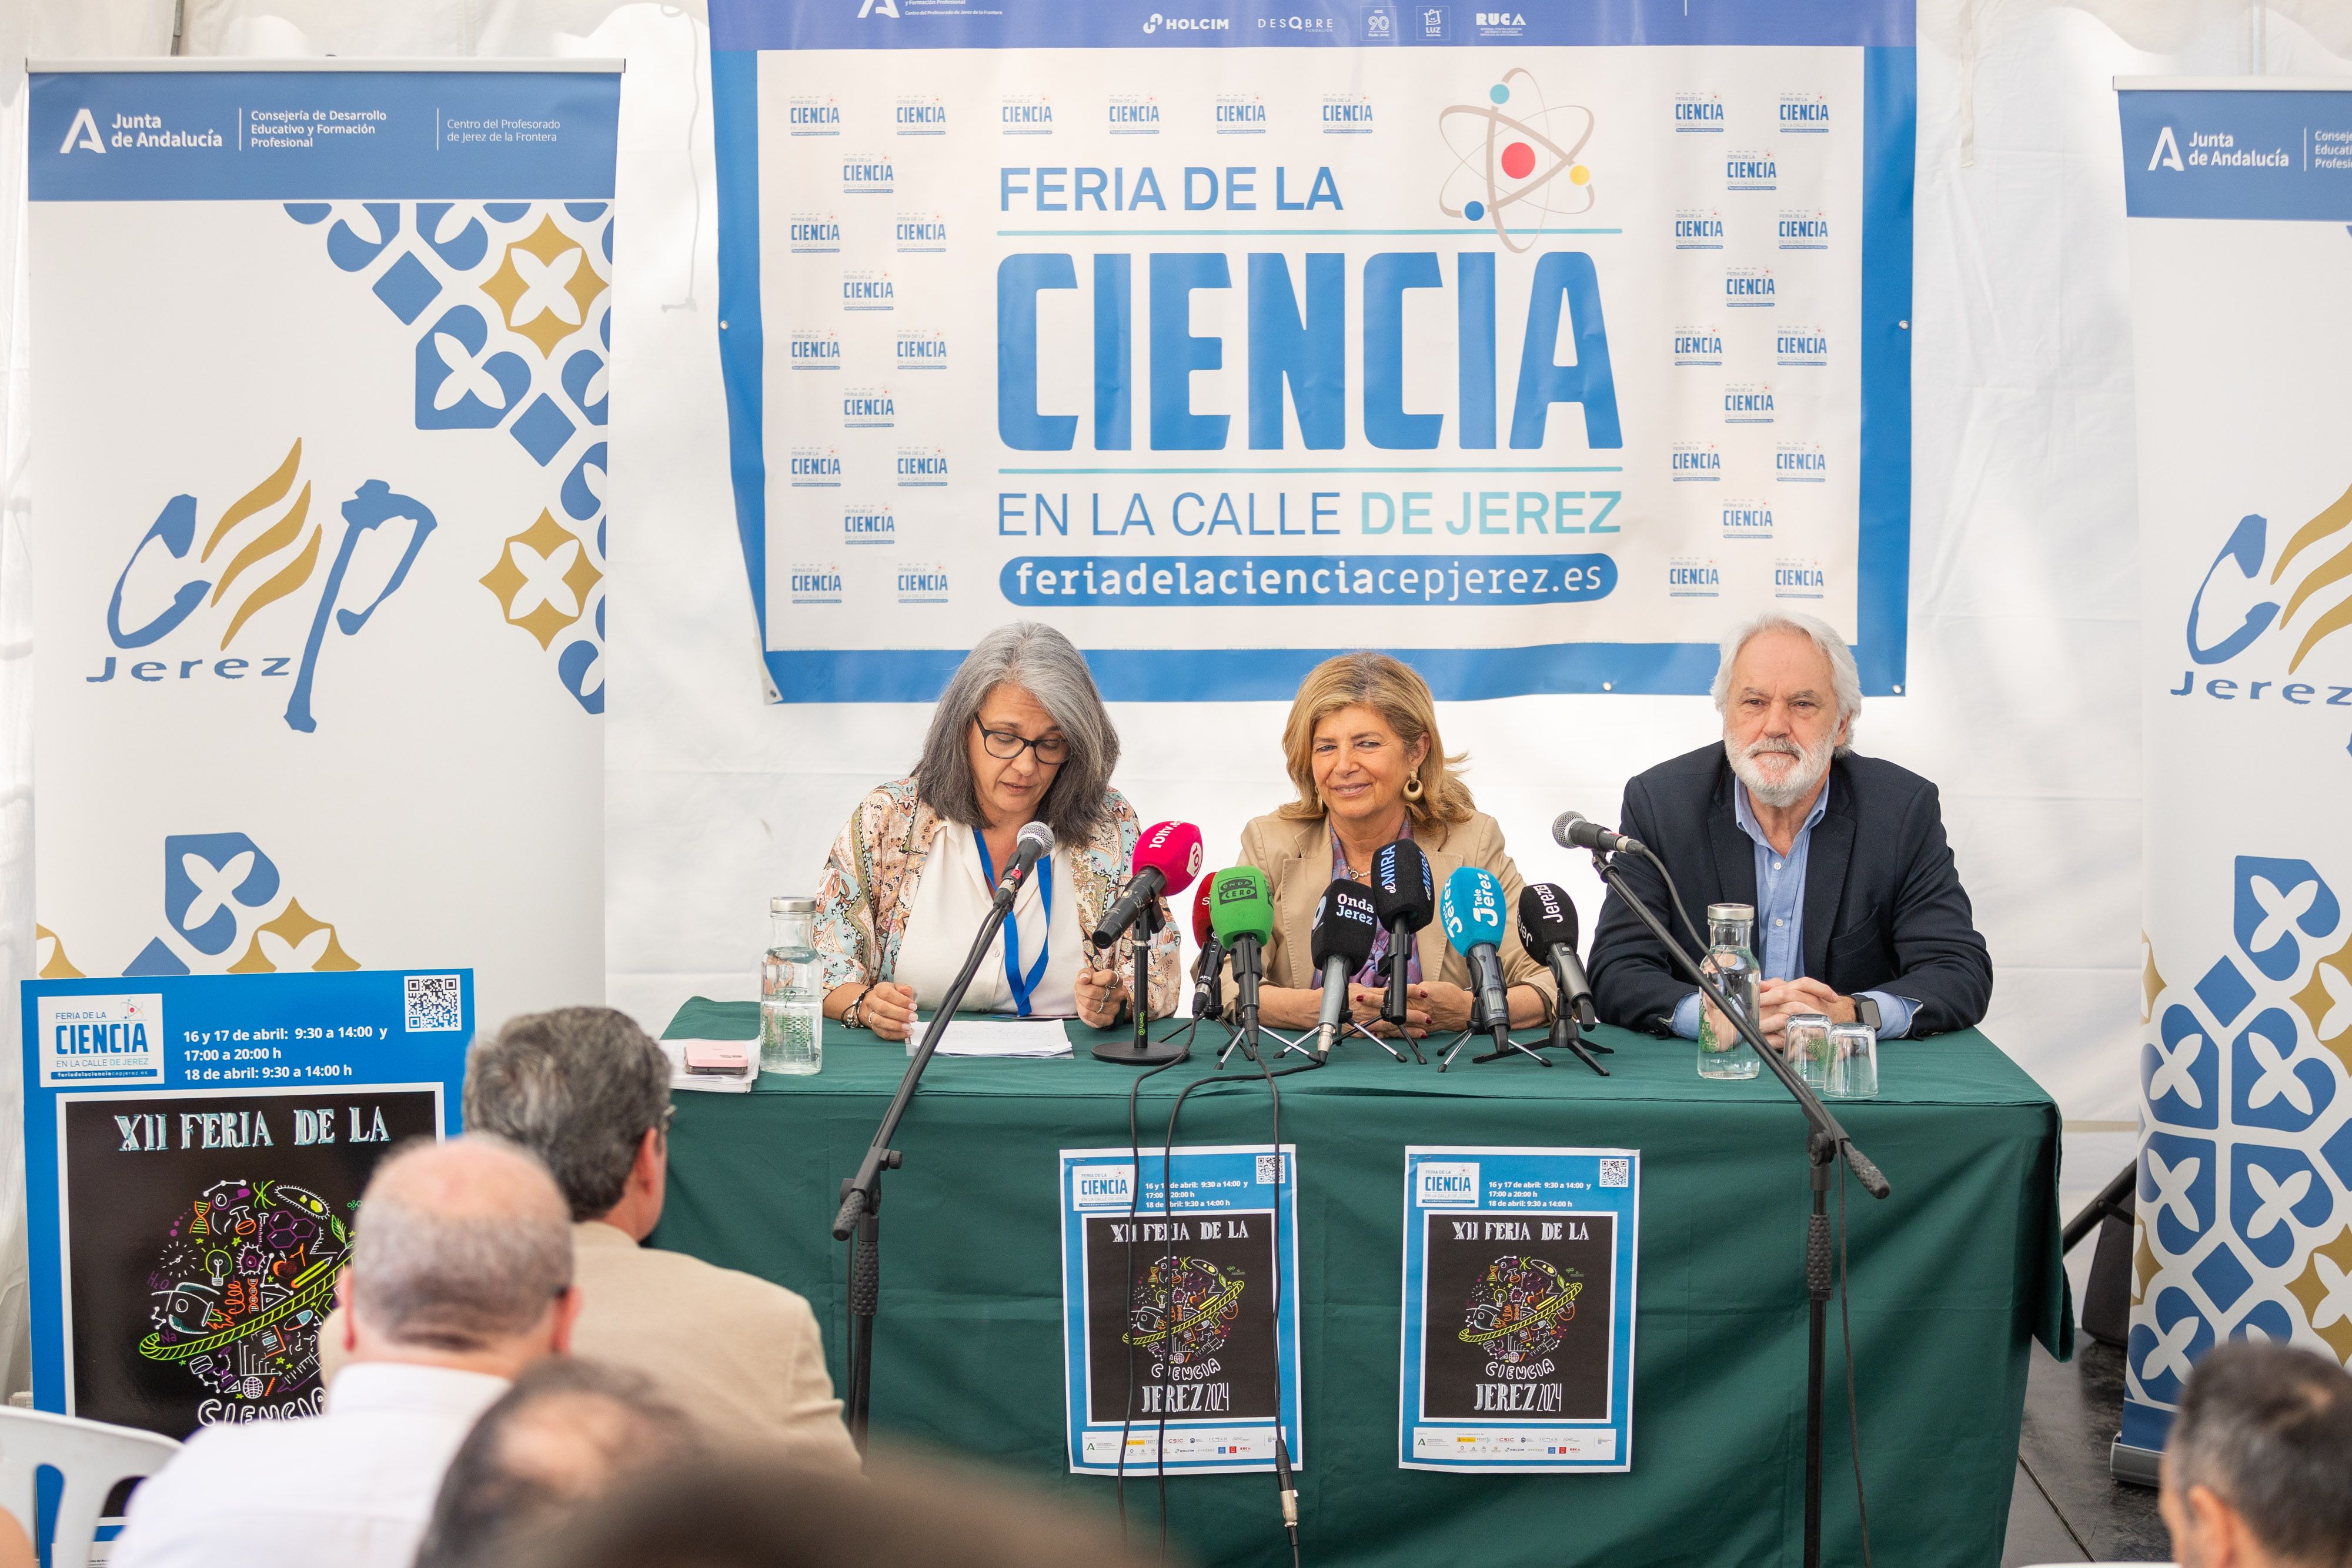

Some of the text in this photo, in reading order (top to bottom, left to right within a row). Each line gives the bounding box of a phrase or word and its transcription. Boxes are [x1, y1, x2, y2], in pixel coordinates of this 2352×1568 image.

[1166, 19, 1229, 30] HOLCIM
[1258, 16, 1333, 31] DESQBRE
[1368, 16, 1389, 30] 90
[1475, 13, 1526, 26] RUCA
[251, 110, 386, 122] Consejería de Desarrollo
[790, 108, 840, 123] CIENCIA
[897, 107, 946, 122] CIENCIA
[1217, 105, 1265, 121] CIENCIA
[1676, 103, 1723, 120] CIENCIA
[1780, 104, 1829, 120] CIENCIA
[112, 113, 161, 129] Junta
[447, 119, 560, 129] Centro del Profesorado
[251, 123, 375, 136] Educativo y Formación
[447, 132, 557, 143] de Jerez de la Frontera
[111, 129, 223, 148] de Andalucía
[251, 137, 313, 148] Profesional
[2189, 132, 2234, 148] Junta
[2189, 148, 2289, 167] de Andalucía
[2315, 158, 2352, 169] Profesi
[1727, 162, 1776, 178] CIENCIA
[1000, 166, 1345, 212] FERIA DE LA
[791, 225, 840, 240] CIENCIA
[997, 252, 1624, 452] CIENCIA
[998, 490, 1623, 537] EN LA CALLE DE JEREZ
[845, 516, 894, 532] CIENCIA
[1015, 561, 1602, 601] feriadelacienciacepjerez.es
[1775, 570, 1824, 586] CIENCIA
[86, 657, 290, 683] Jerez
[1222, 881, 1251, 890] ONDA
[1225, 889, 1252, 899] CERO
[1472, 872, 1498, 927] Jerez
[1474, 888, 1484, 907] Tele
[1337, 894, 1375, 914] Onda
[1444, 878, 1463, 938] Jerez
[1537, 888, 1564, 923] Jerez
[1336, 905, 1373, 925] Jerez
[1517, 907, 1533, 947] Jere
[55, 1012, 81, 1020] FERIA
[82, 1011, 94, 1019] DE
[56, 1023, 148, 1055] CIENCIA
[183, 1026, 388, 1045] 16 y 17 de abril: 9:30 a 14:00 y
[184, 1047, 282, 1061] 17:00 a 20:00 h
[82, 1059, 107, 1067] CALLE
[122, 1058, 149, 1066] JEREZ
[184, 1064, 352, 1081] 18 de abril: 9:30 a 14:00 h
[115, 1105, 391, 1152] XII FERIA DE LA
[1081, 1179, 1128, 1195] CIENCIA
[1425, 1176, 1471, 1192] CIENCIA
[1200, 1222, 1222, 1240] DE
[1228, 1220, 1250, 1239] LA
[1452, 1222, 1589, 1241] XII FERIA DE LA
[1485, 1358, 1555, 1380] CIENCIA
[1141, 1382, 1230, 1413] JEREZ 2024
[1474, 1383, 1562, 1412] JEREZ 2024
